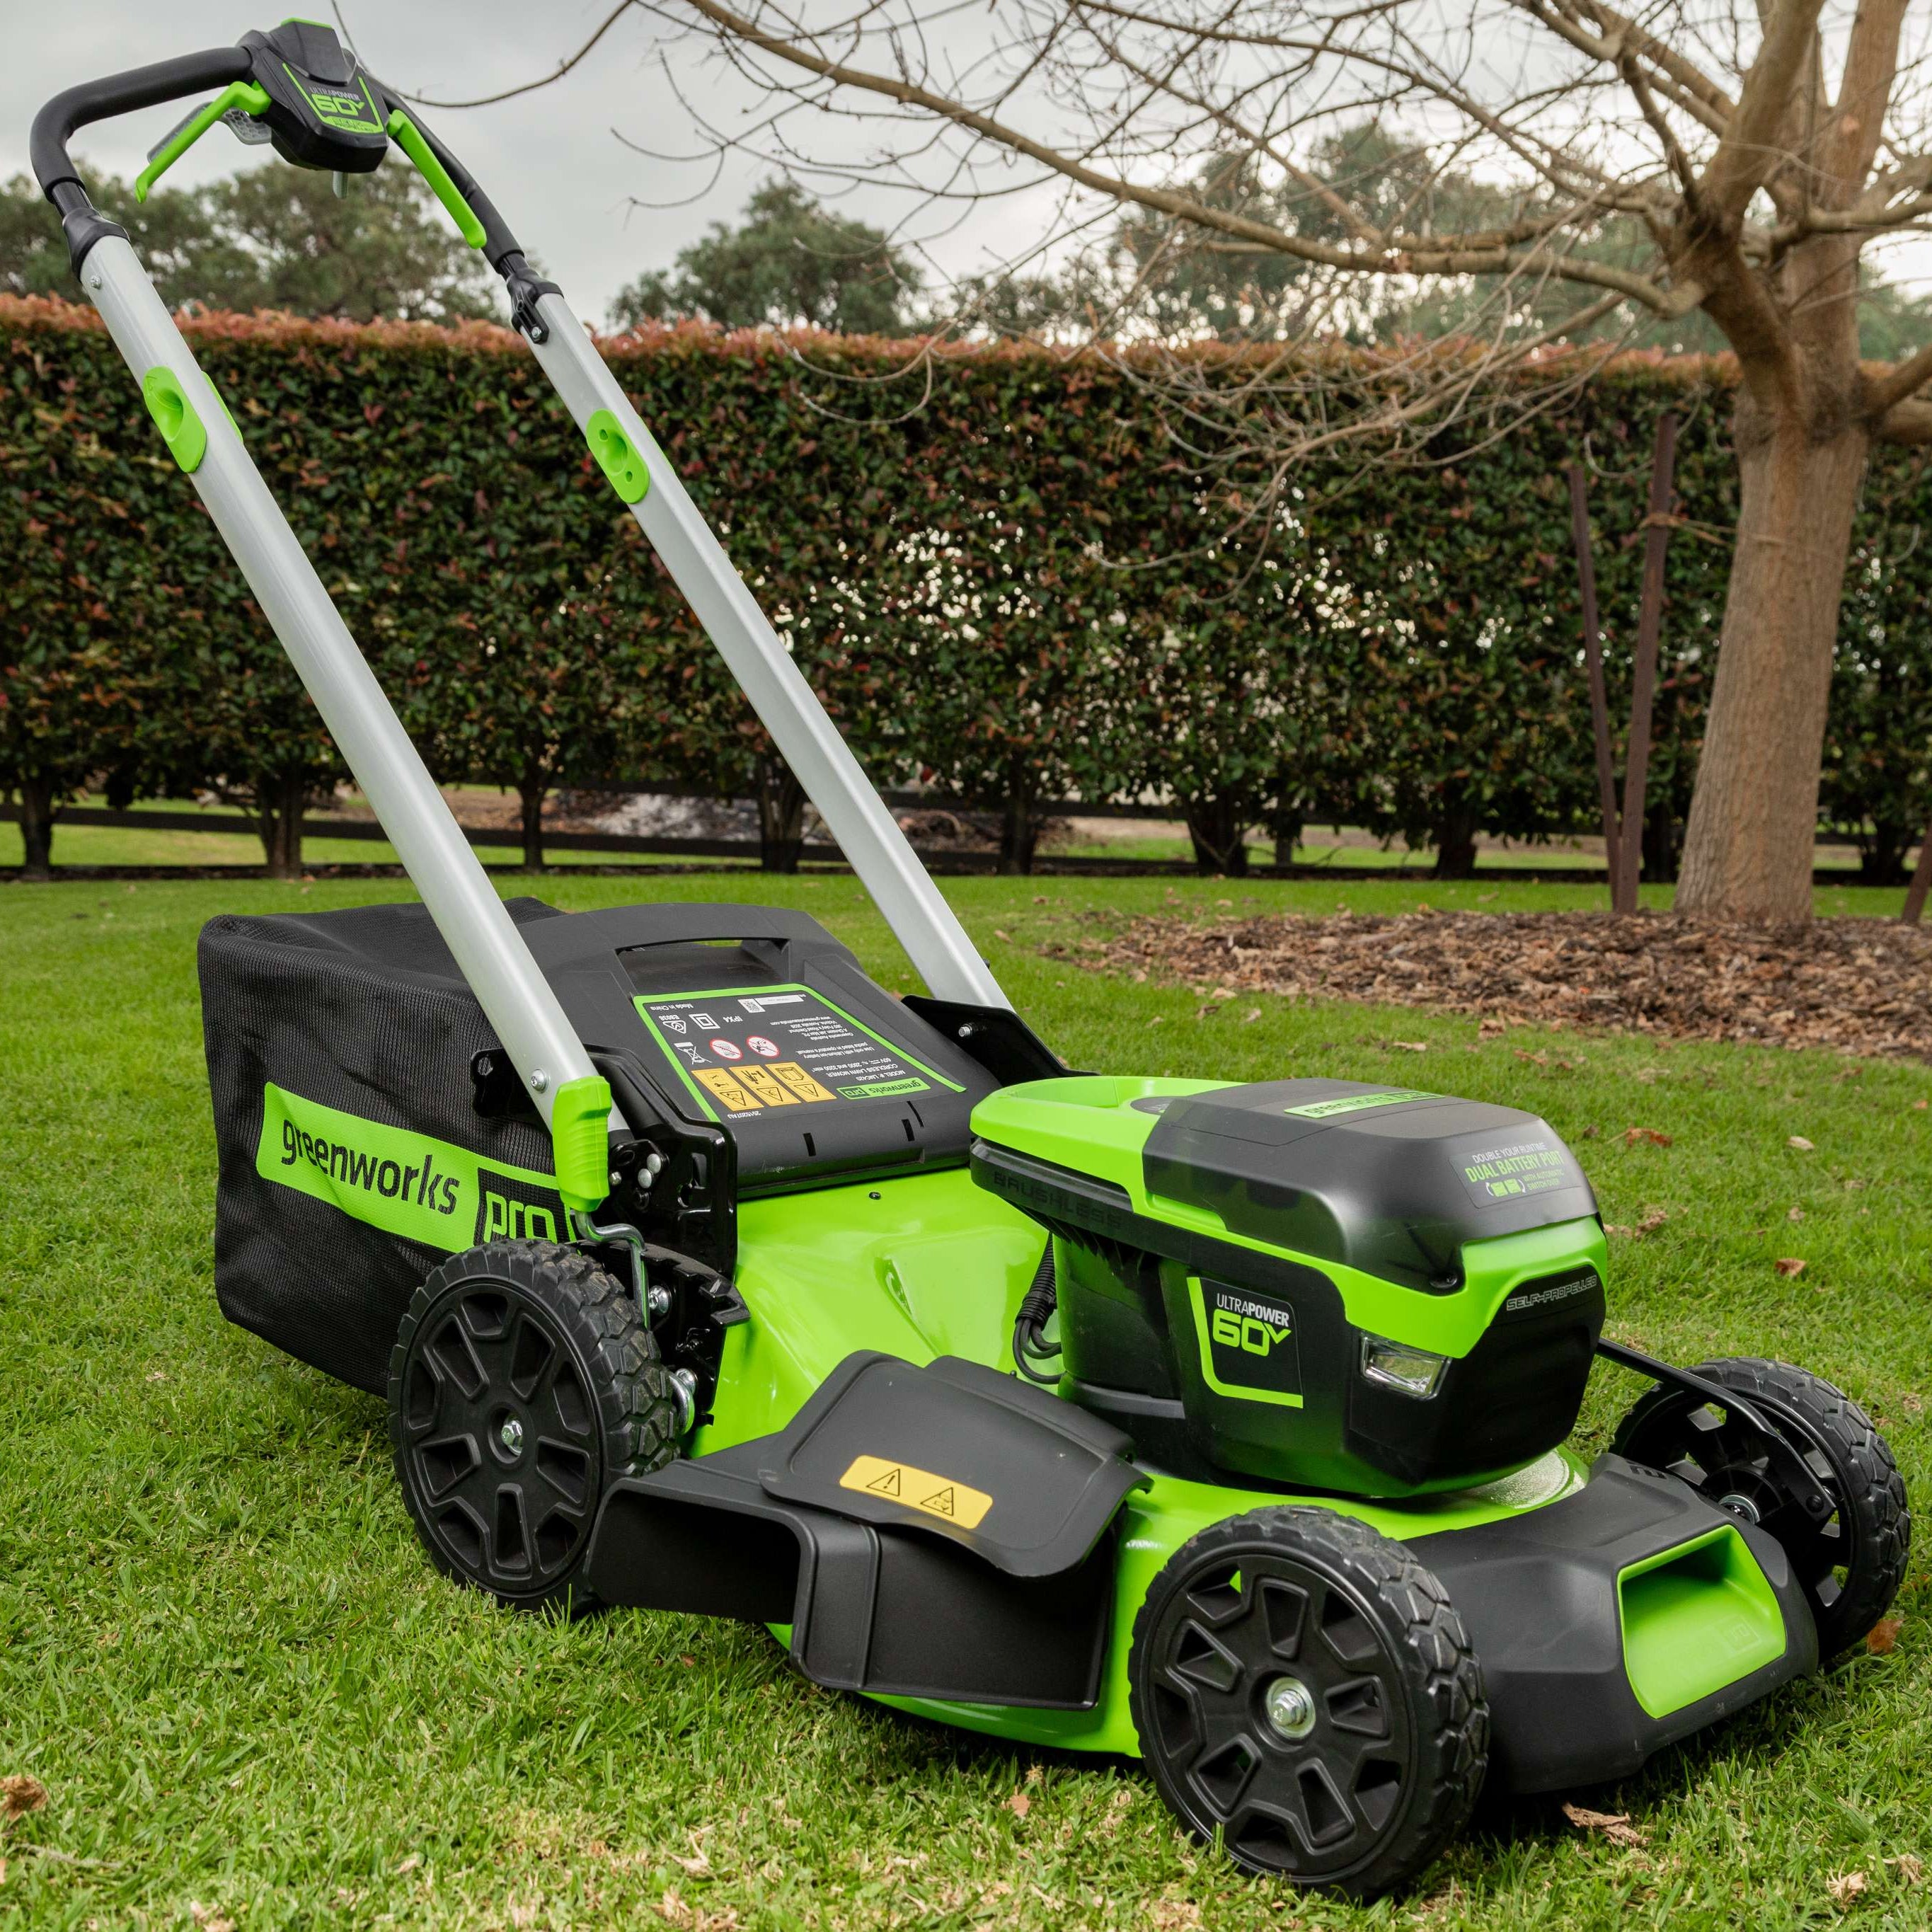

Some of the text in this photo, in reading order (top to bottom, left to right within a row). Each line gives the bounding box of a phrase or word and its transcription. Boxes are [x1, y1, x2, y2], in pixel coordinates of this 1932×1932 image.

[866, 1064, 898, 1072] CORDLESS
[869, 1081, 921, 1093] greenworks
[1465, 1151, 1565, 1183] DUAL BATTERY PORT
[1472, 1150, 1502, 1163] DOUBLE
[1501, 1146, 1520, 1158] YOUR
[281, 1119, 558, 1243] greenworks pro
[1216, 1293, 1290, 1327] ULTRAPOWER
[1212, 1309, 1292, 1357] 60V
